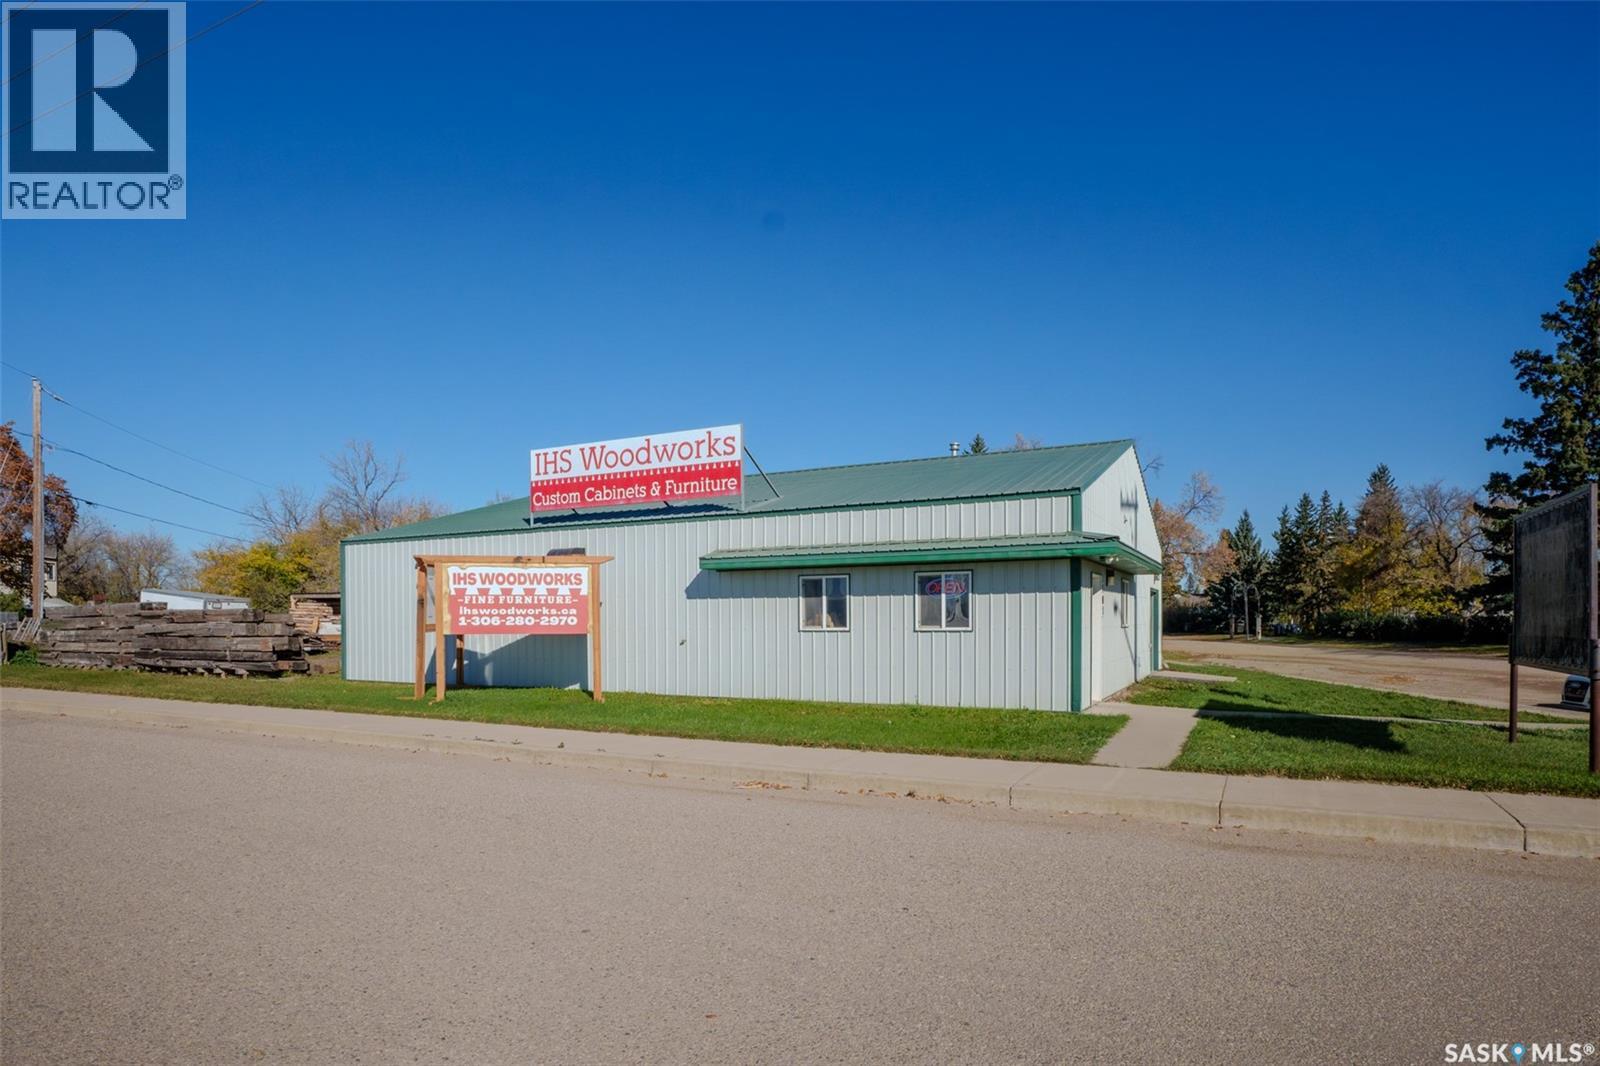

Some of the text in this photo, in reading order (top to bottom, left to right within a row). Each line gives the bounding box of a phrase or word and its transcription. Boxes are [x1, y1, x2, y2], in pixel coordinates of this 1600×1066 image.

[535, 431, 736, 476] IHS Woodworks
[532, 477, 738, 506] Custom Cabinets & Furniture
[452, 572, 583, 586] IHS WOODWORKS
[459, 606, 577, 616] ihswoodworks.ca
[458, 615, 578, 627] 1-306-280-2970
